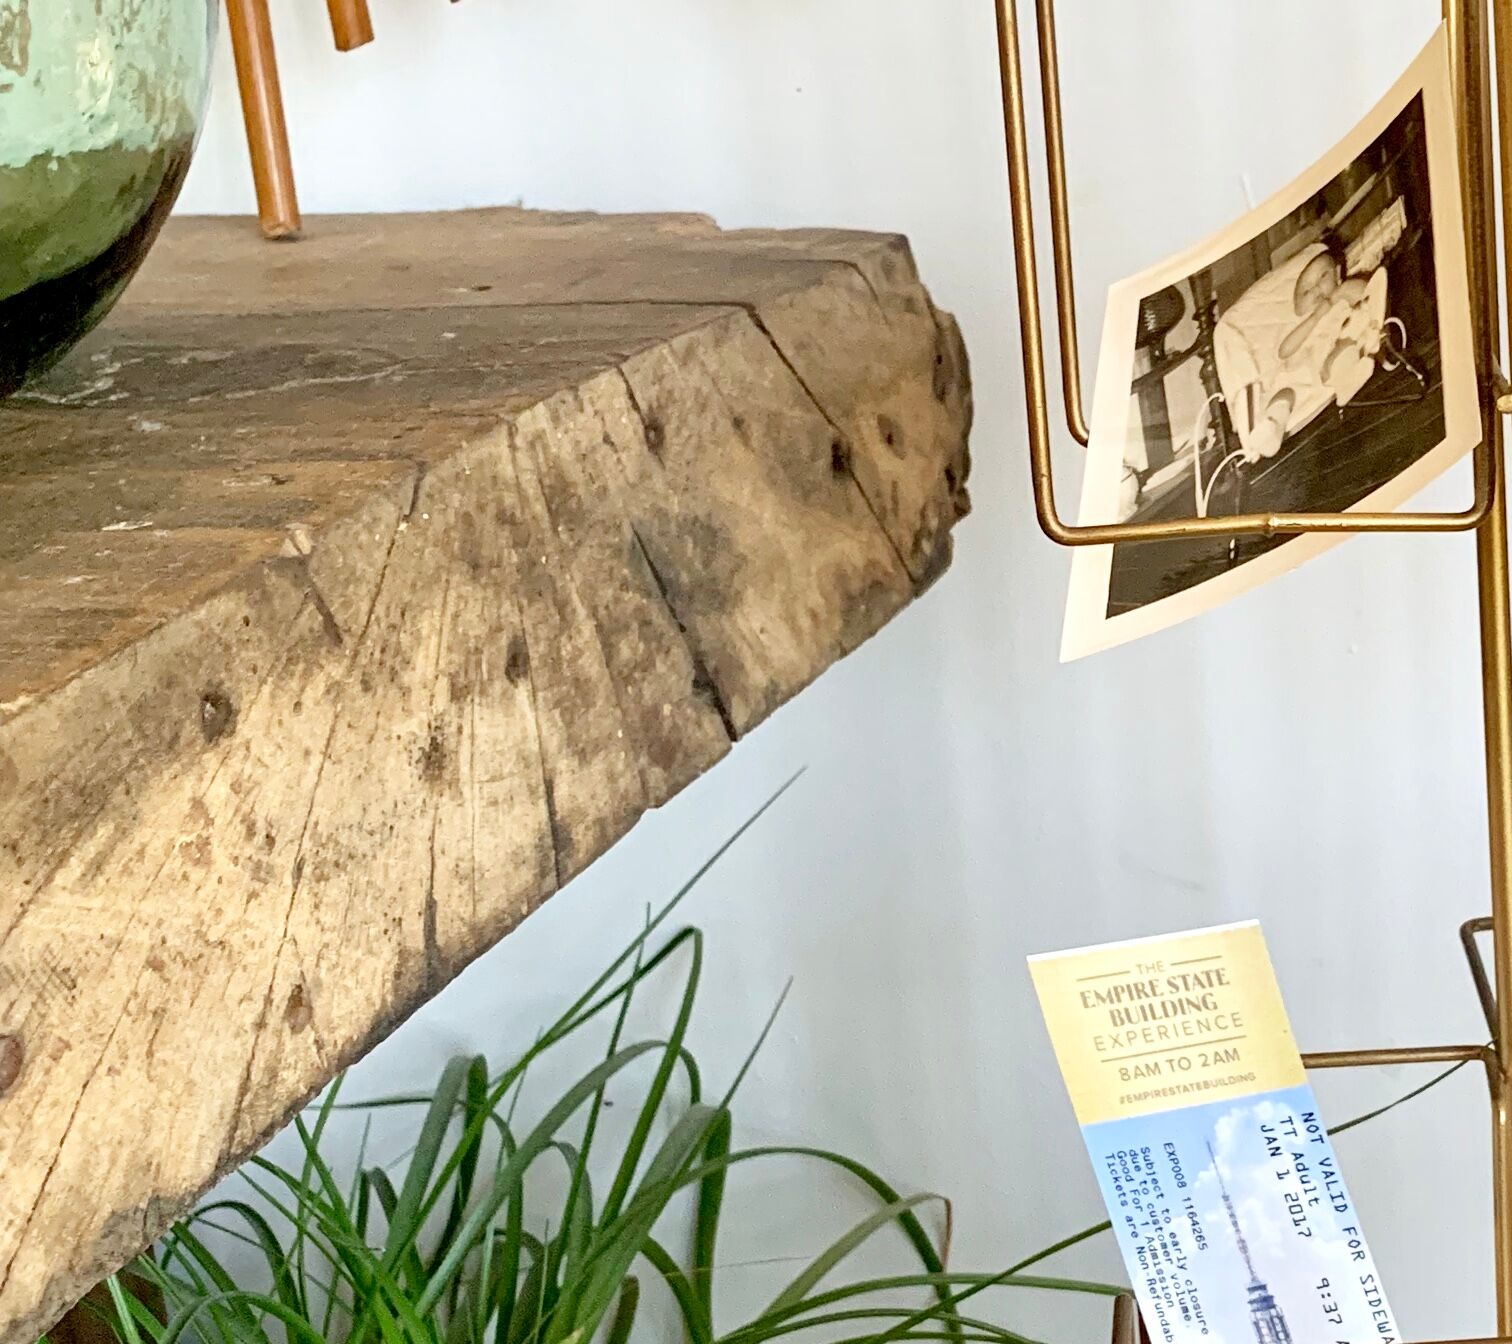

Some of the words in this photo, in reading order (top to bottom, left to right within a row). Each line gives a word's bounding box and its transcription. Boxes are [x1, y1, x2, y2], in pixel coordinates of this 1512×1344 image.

[1077, 977, 1165, 1010] EMPIRE
[1163, 966, 1232, 995] STATE
[1133, 959, 1167, 977] THE
[1090, 1010, 1245, 1053] EXPERIENCE
[1106, 991, 1220, 1028] BUILDING
[1164, 1054, 1194, 1074] TO
[1116, 1070, 1258, 1106] #EMPIRESTATEBUILDING
[1126, 1147, 1145, 1173] due
[1258, 1122, 1284, 1158] JAN
[1276, 1114, 1298, 1140] TT
[1289, 1149, 1323, 1208] Adult
[1136, 1145, 1167, 1201] Subject
[1137, 1179, 1152, 1197] to
[1274, 1167, 1292, 1181] 1
[1299, 1110, 1326, 1147] NOT
[1316, 1156, 1350, 1214] VALID
[1340, 1224, 1367, 1262] FOR
[1102, 1151, 1131, 1208] Tickets
[1123, 1213, 1141, 1240] are
[1159, 1206, 1175, 1225] to
[1161, 1140, 1188, 1190] EXP008
[1180, 1195, 1209, 1252] 1164265
[1282, 1190, 1313, 1240] 2017
[1114, 1149, 1135, 1183] Good
[1127, 1187, 1145, 1213] For
[1143, 1234, 1178, 1309] Admission
[1144, 1200, 1176, 1266] customer
[1164, 1229, 1191, 1272] early
[1168, 1271, 1197, 1330] volume.
[1182, 1277, 1212, 1337] closure
[1312, 1276, 1344, 1327] 9:37
